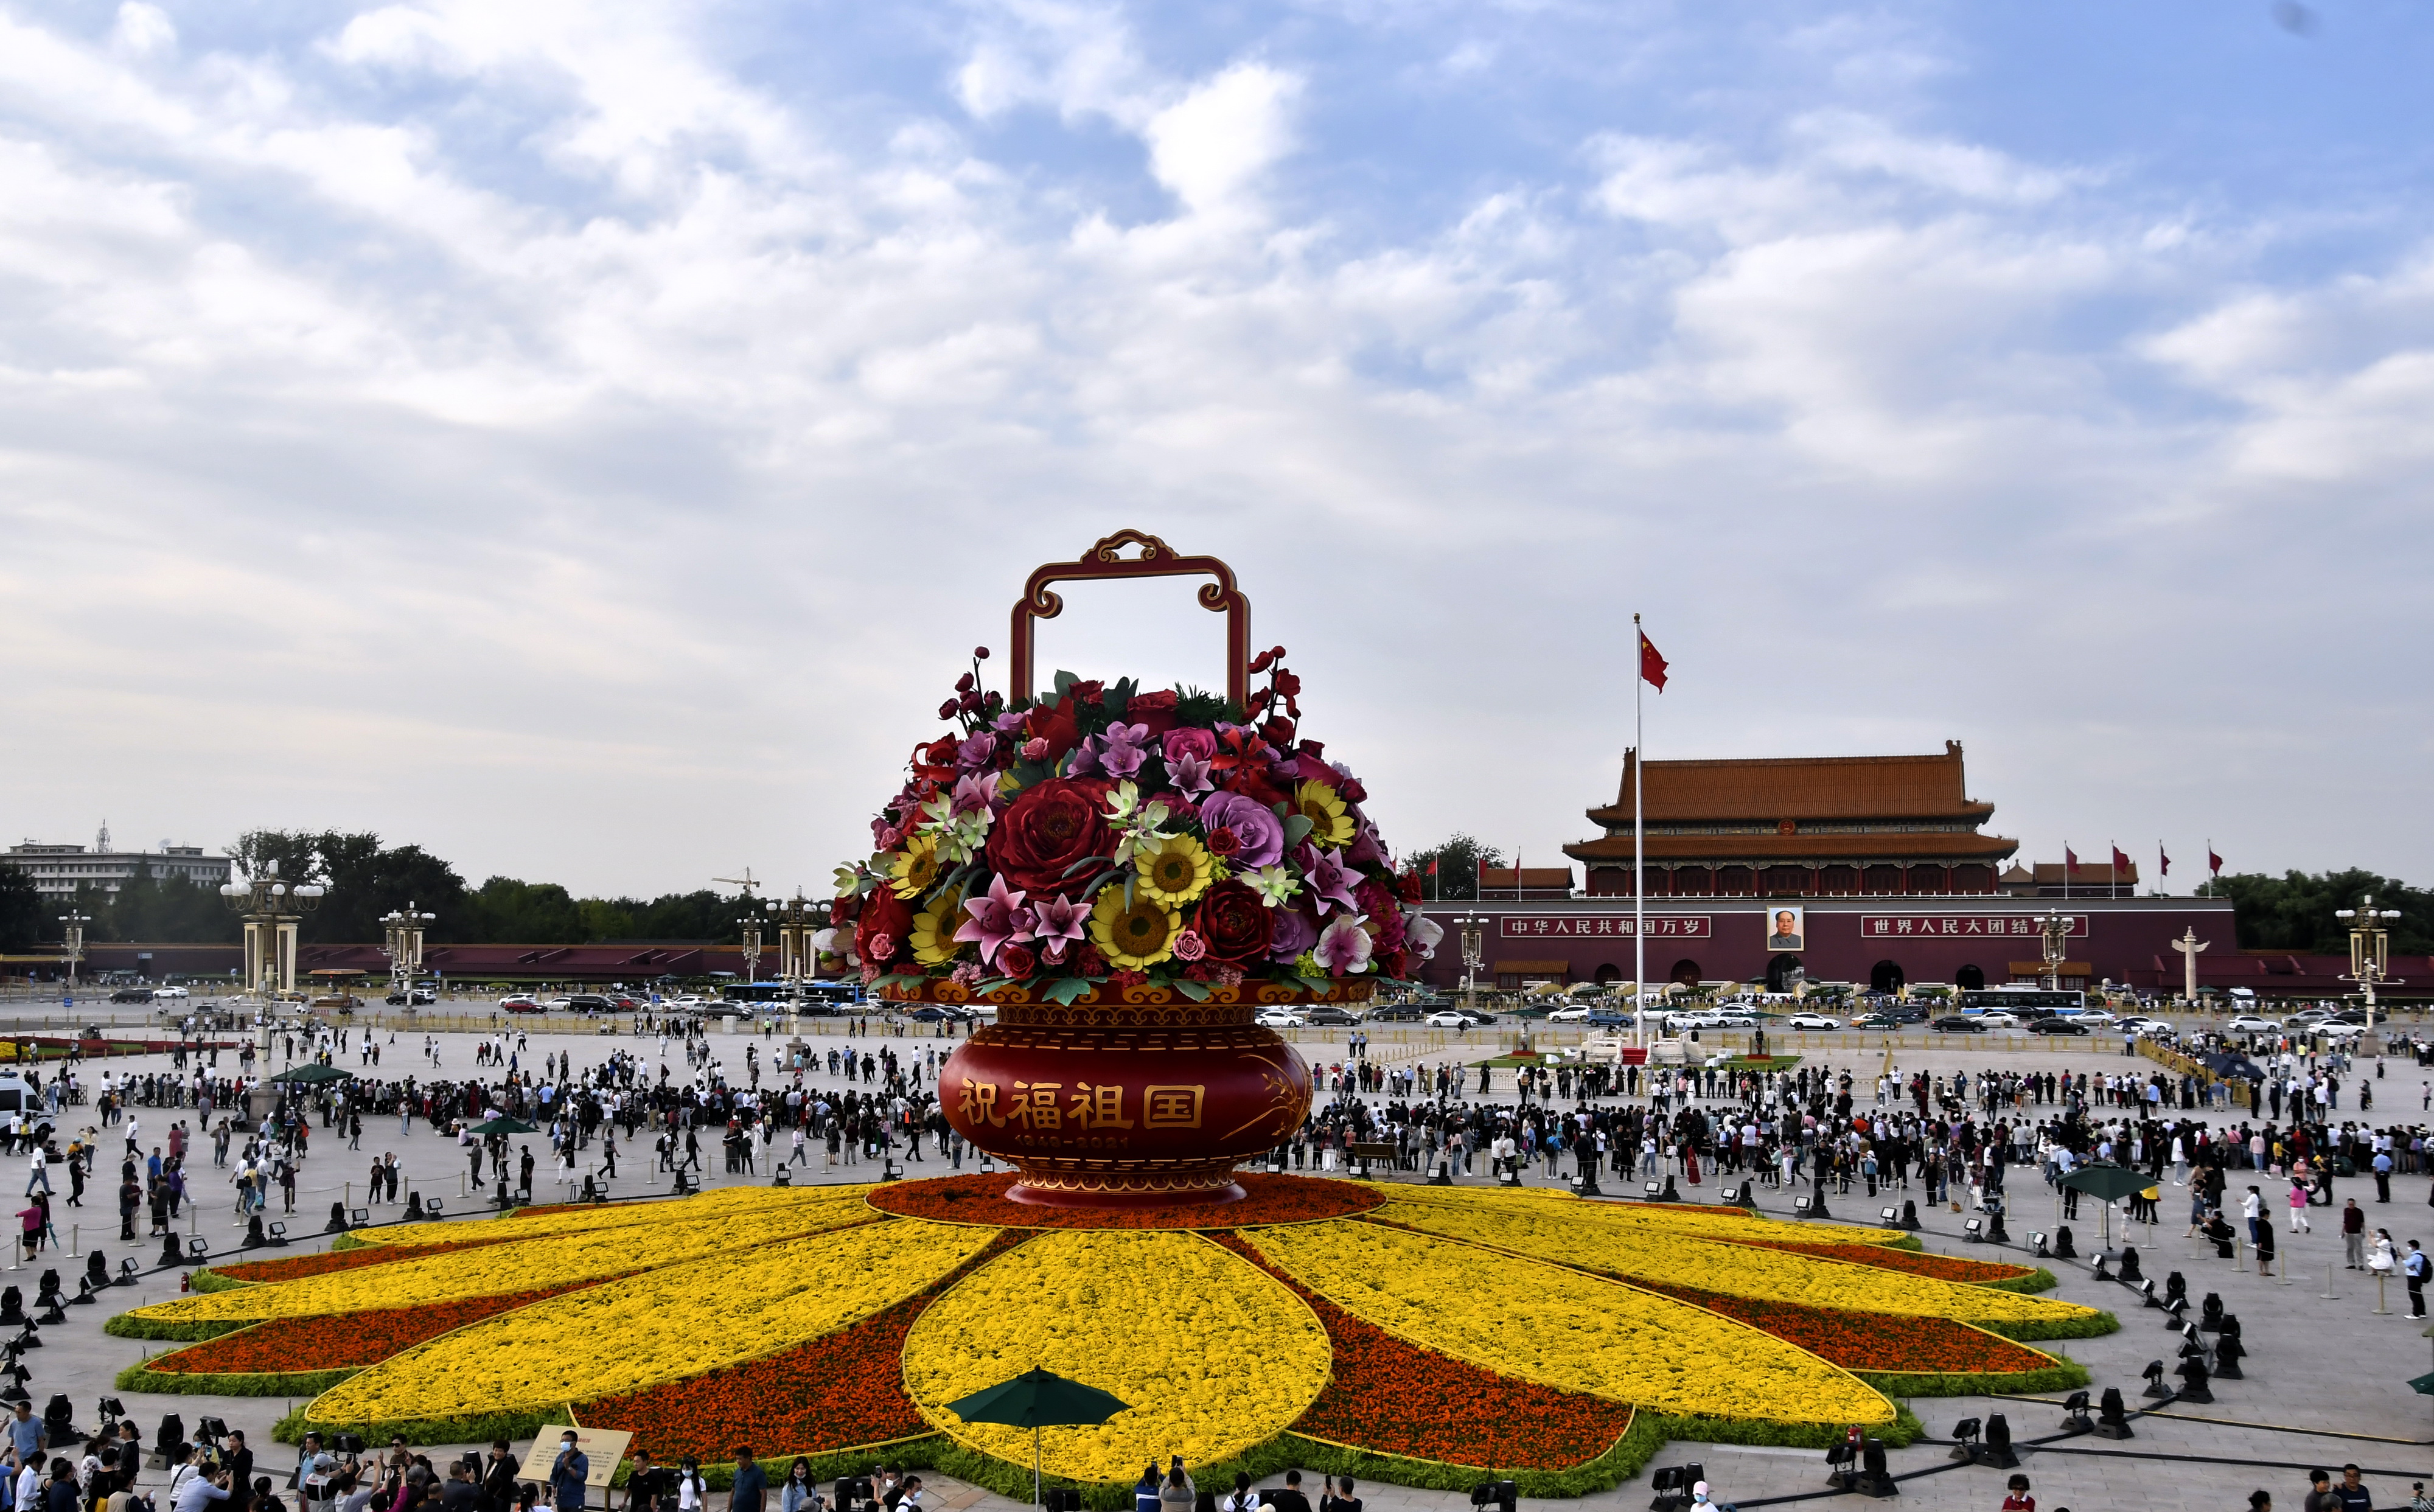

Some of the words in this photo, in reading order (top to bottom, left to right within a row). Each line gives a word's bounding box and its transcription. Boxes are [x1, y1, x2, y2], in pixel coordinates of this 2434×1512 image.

[1512, 920, 1700, 935] 中华人民共和国万岁
[958, 1077, 1205, 1130] 祝福祖国
[1014, 1135, 1128, 1149] 1949-2021
